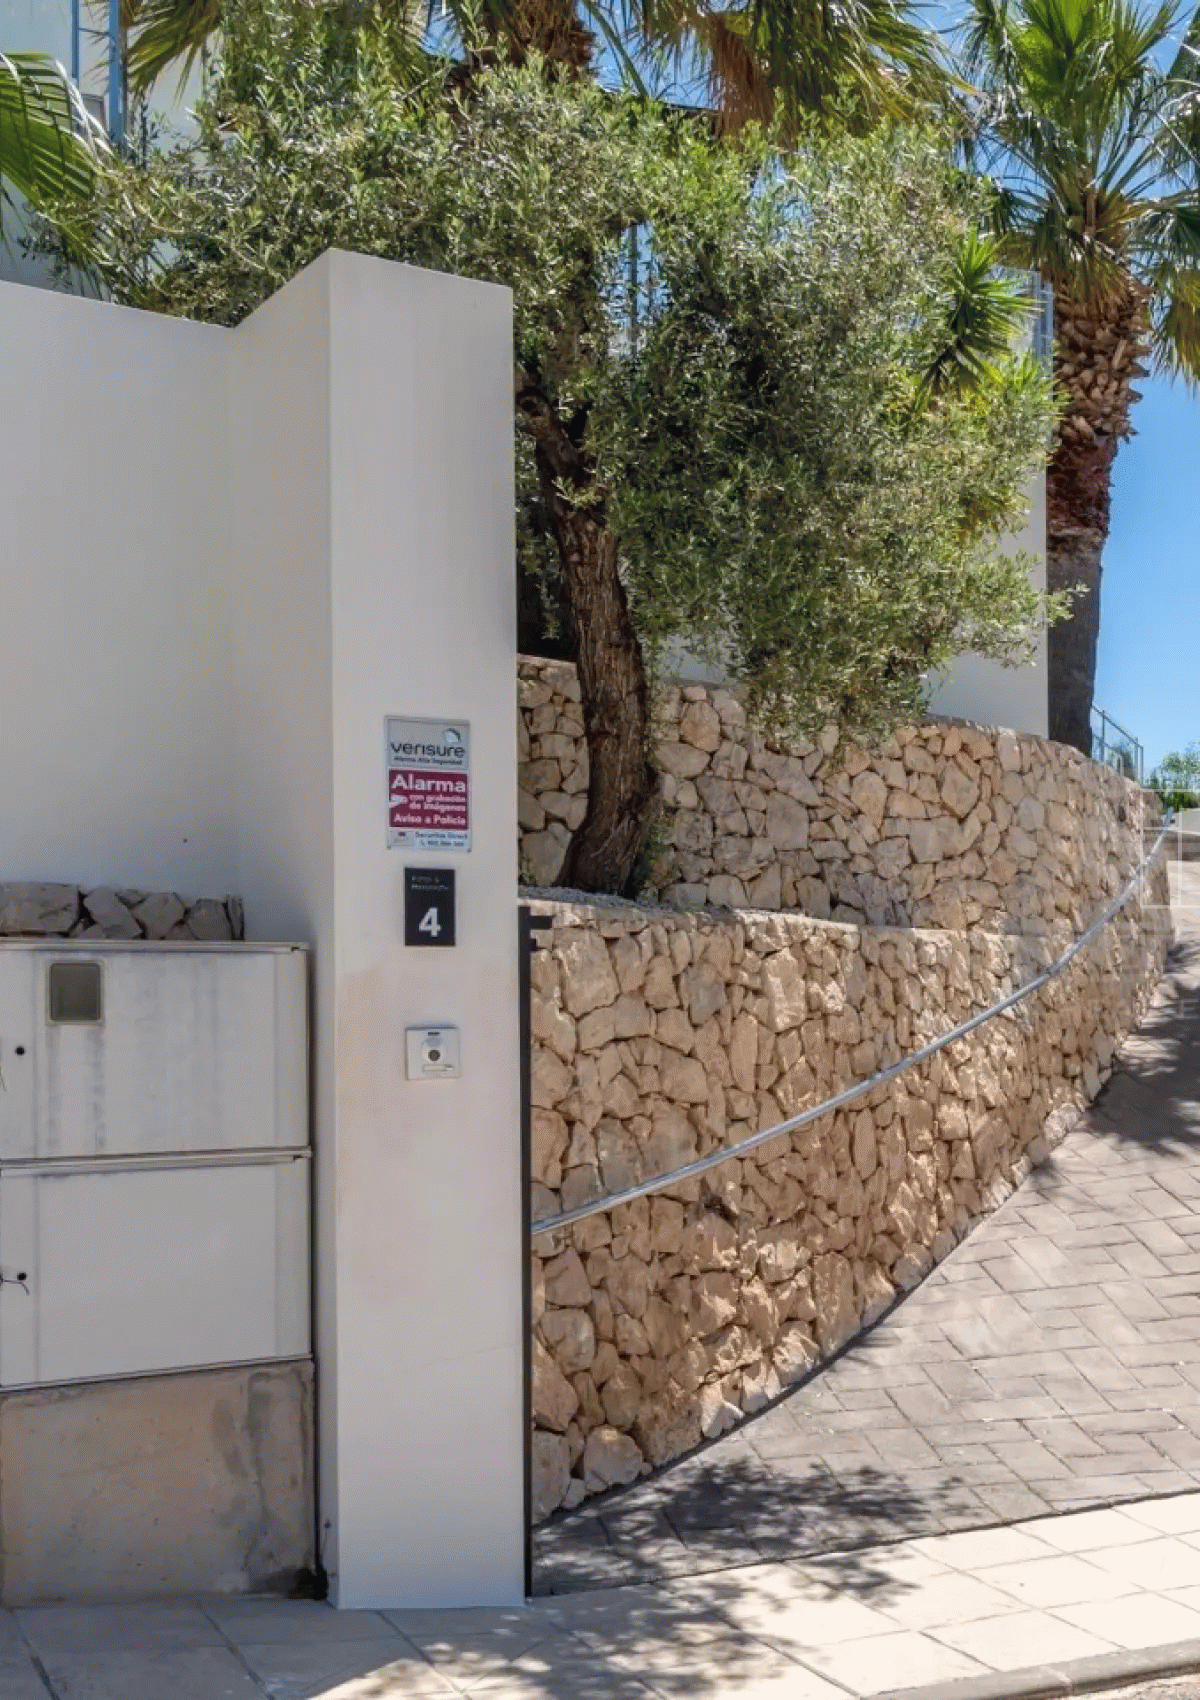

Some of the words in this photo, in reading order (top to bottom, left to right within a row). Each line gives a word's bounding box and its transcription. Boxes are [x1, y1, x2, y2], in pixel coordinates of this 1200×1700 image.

[390, 743, 466, 757] verisure
[392, 774, 466, 792] Alarma
[394, 813, 422, 823] Aviso
[418, 907, 442, 938] 4
